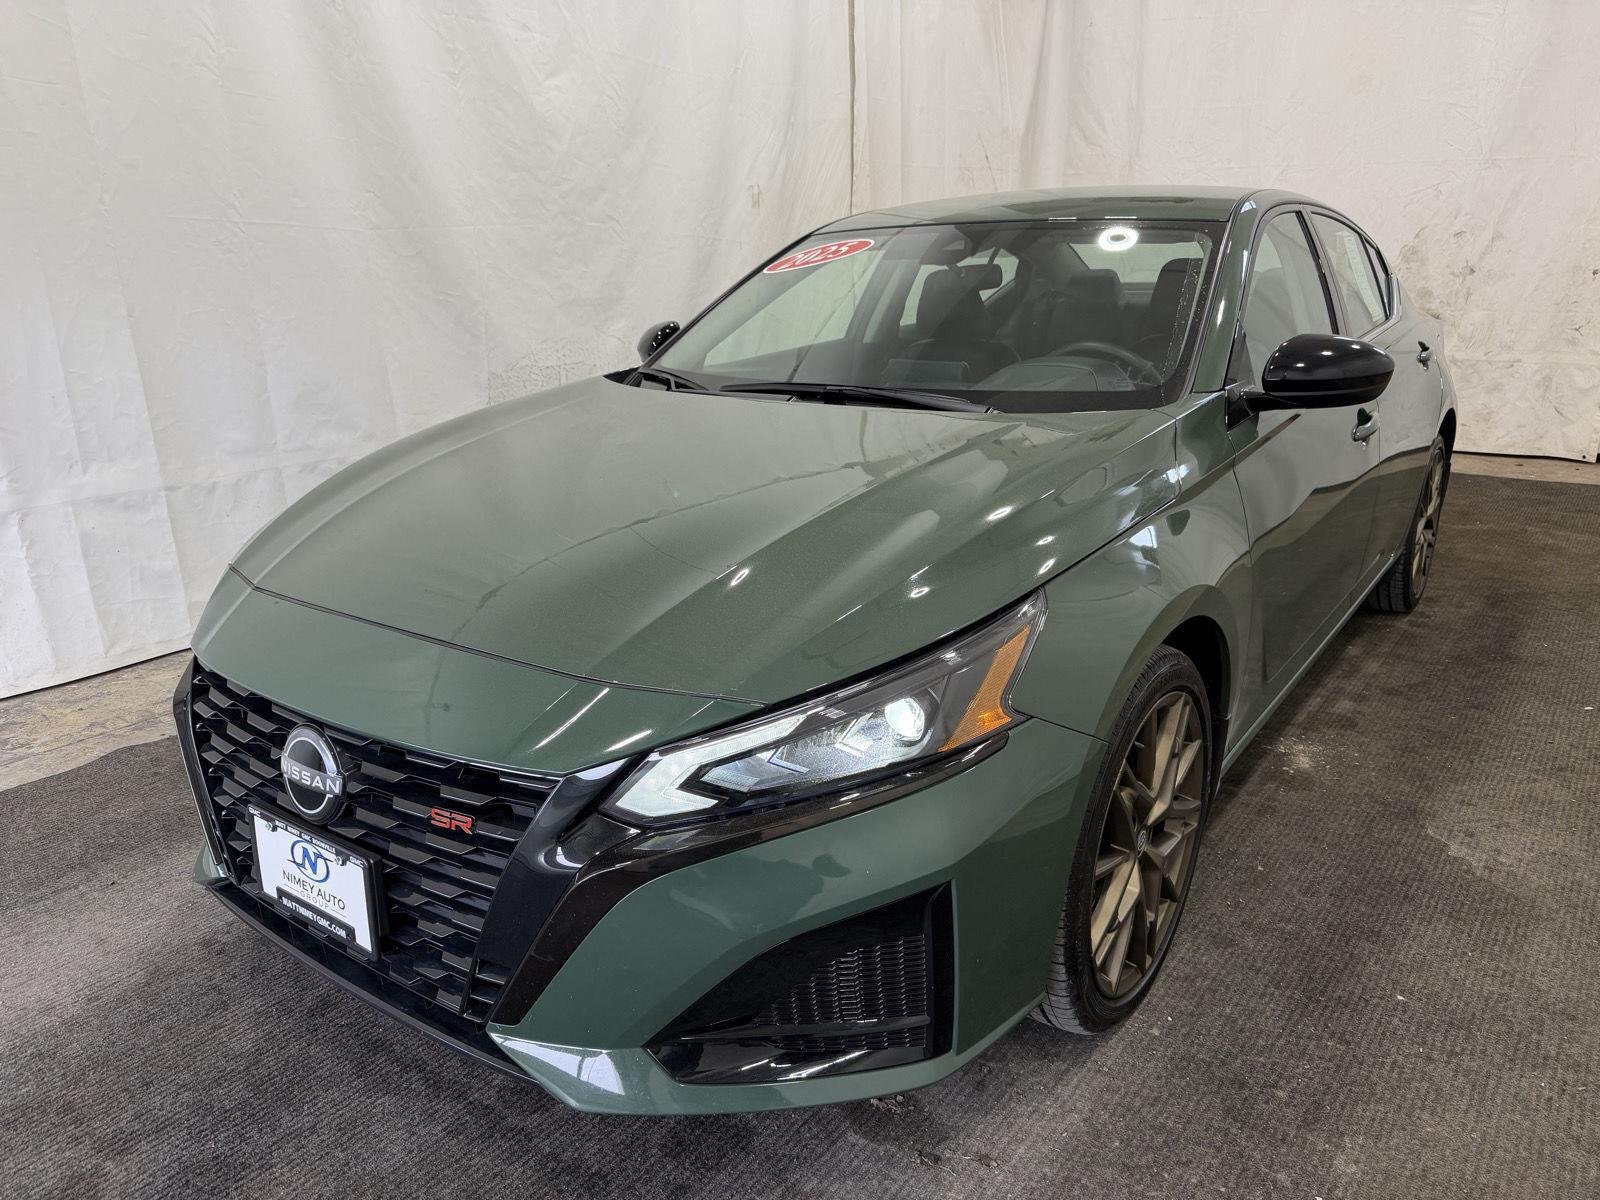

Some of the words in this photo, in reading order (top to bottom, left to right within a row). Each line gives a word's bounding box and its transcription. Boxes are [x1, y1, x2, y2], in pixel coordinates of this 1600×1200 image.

[777, 241, 860, 270] 2025
[281, 756, 341, 794] NISSAN
[430, 808, 473, 835] SR
[282, 870, 318, 894] NIMEY
[316, 886, 346, 910] AUTO
[300, 890, 330, 909] GROUP
